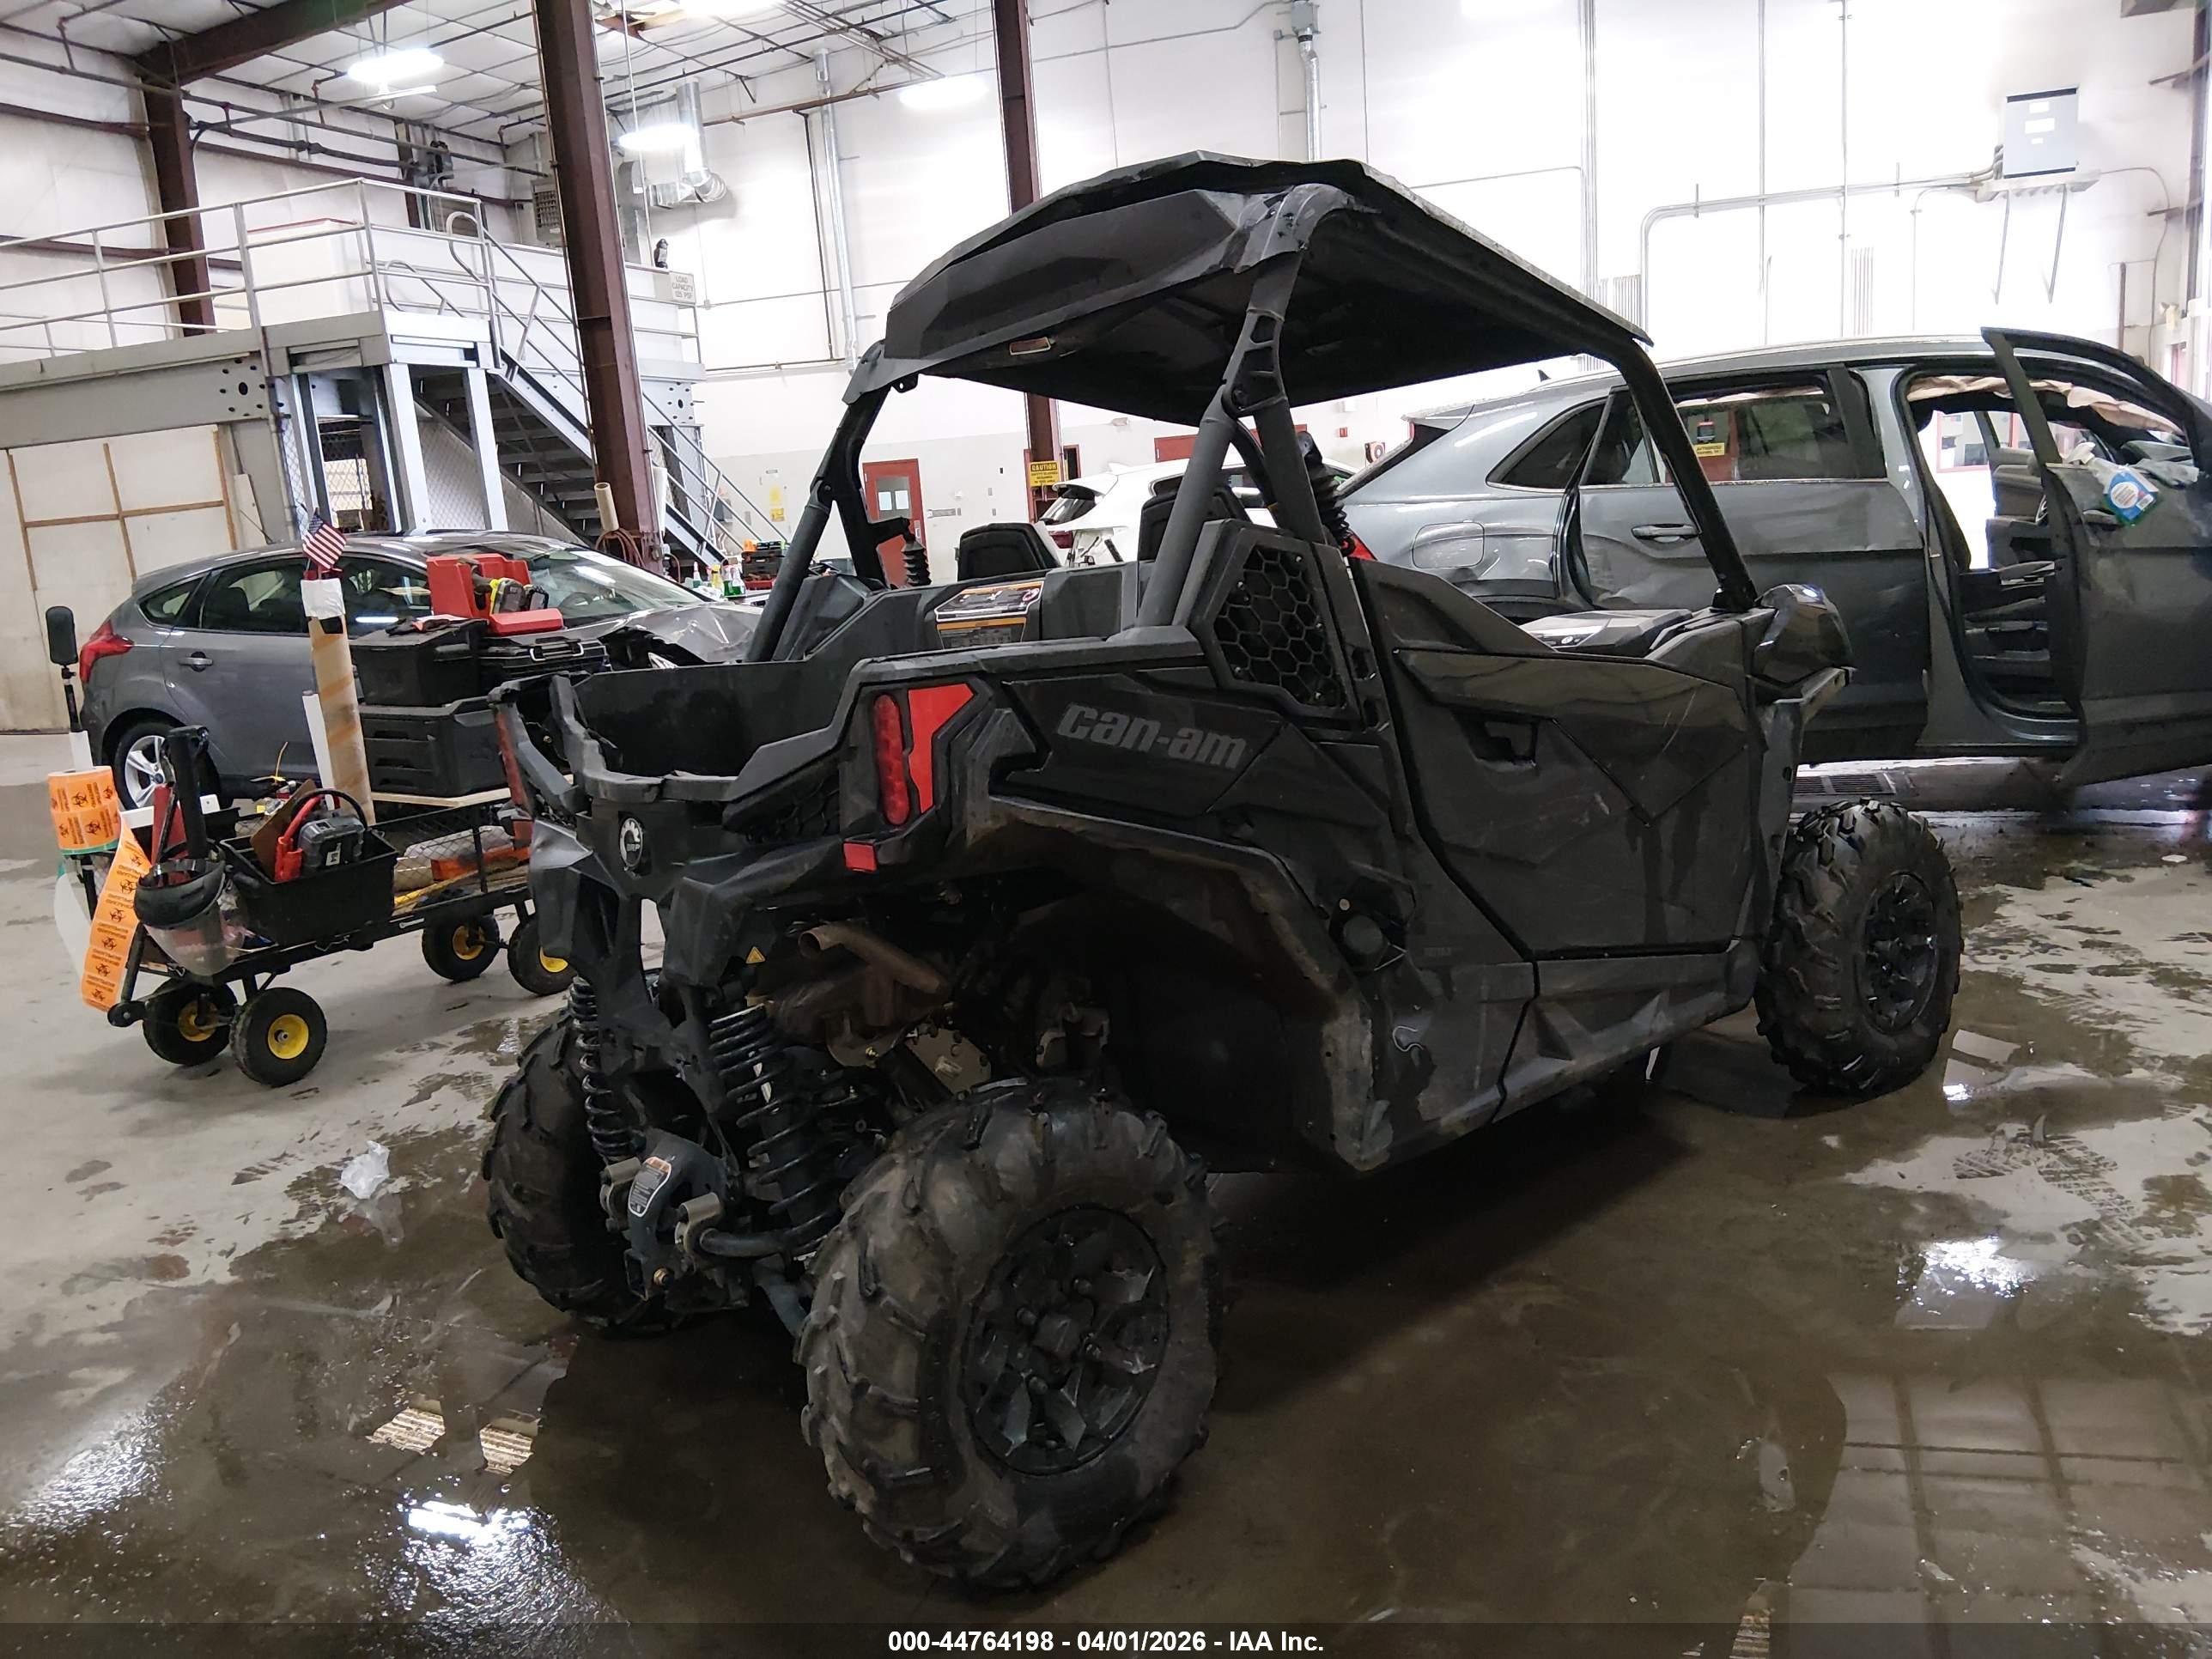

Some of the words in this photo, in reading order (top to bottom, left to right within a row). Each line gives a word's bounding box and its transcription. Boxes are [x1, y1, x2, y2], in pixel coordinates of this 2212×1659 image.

[676, 275, 689, 283] LOAD
[672, 282, 694, 292] CAPACITY
[1031, 463, 1057, 471] CAUTION
